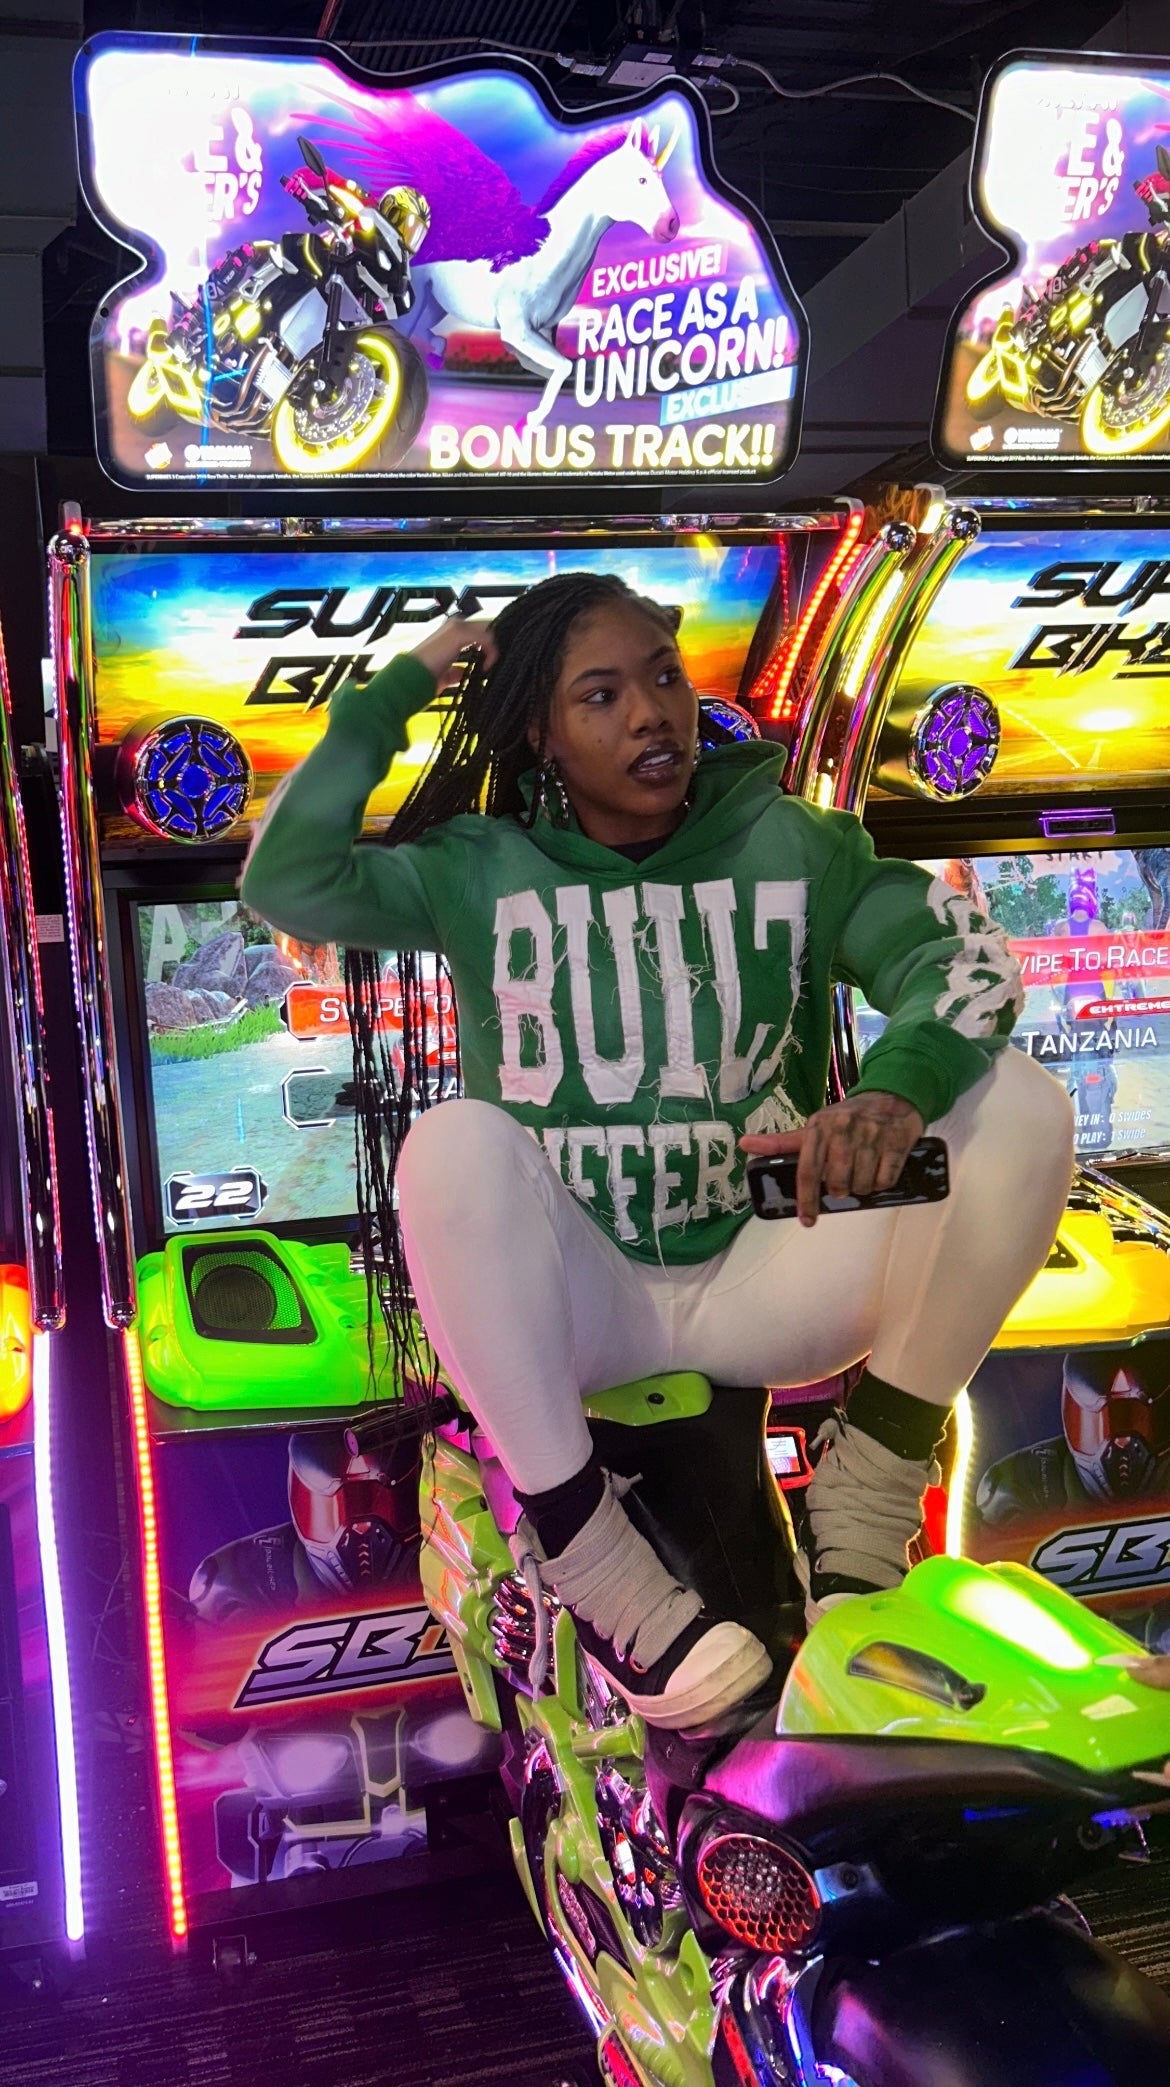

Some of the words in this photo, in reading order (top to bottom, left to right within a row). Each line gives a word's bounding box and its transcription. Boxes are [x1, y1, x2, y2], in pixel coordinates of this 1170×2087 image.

[1102, 118, 1125, 177] &
[593, 246, 723, 297] EXCLUSIVE!
[577, 292, 675, 355] RACE
[679, 282, 728, 335] AS
[731, 275, 759, 325] A
[575, 316, 788, 407] UNICORN!
[429, 424, 596, 469] BONUS
[606, 422, 776, 467] TRACK!!
[175, 1181, 255, 1211] 22
